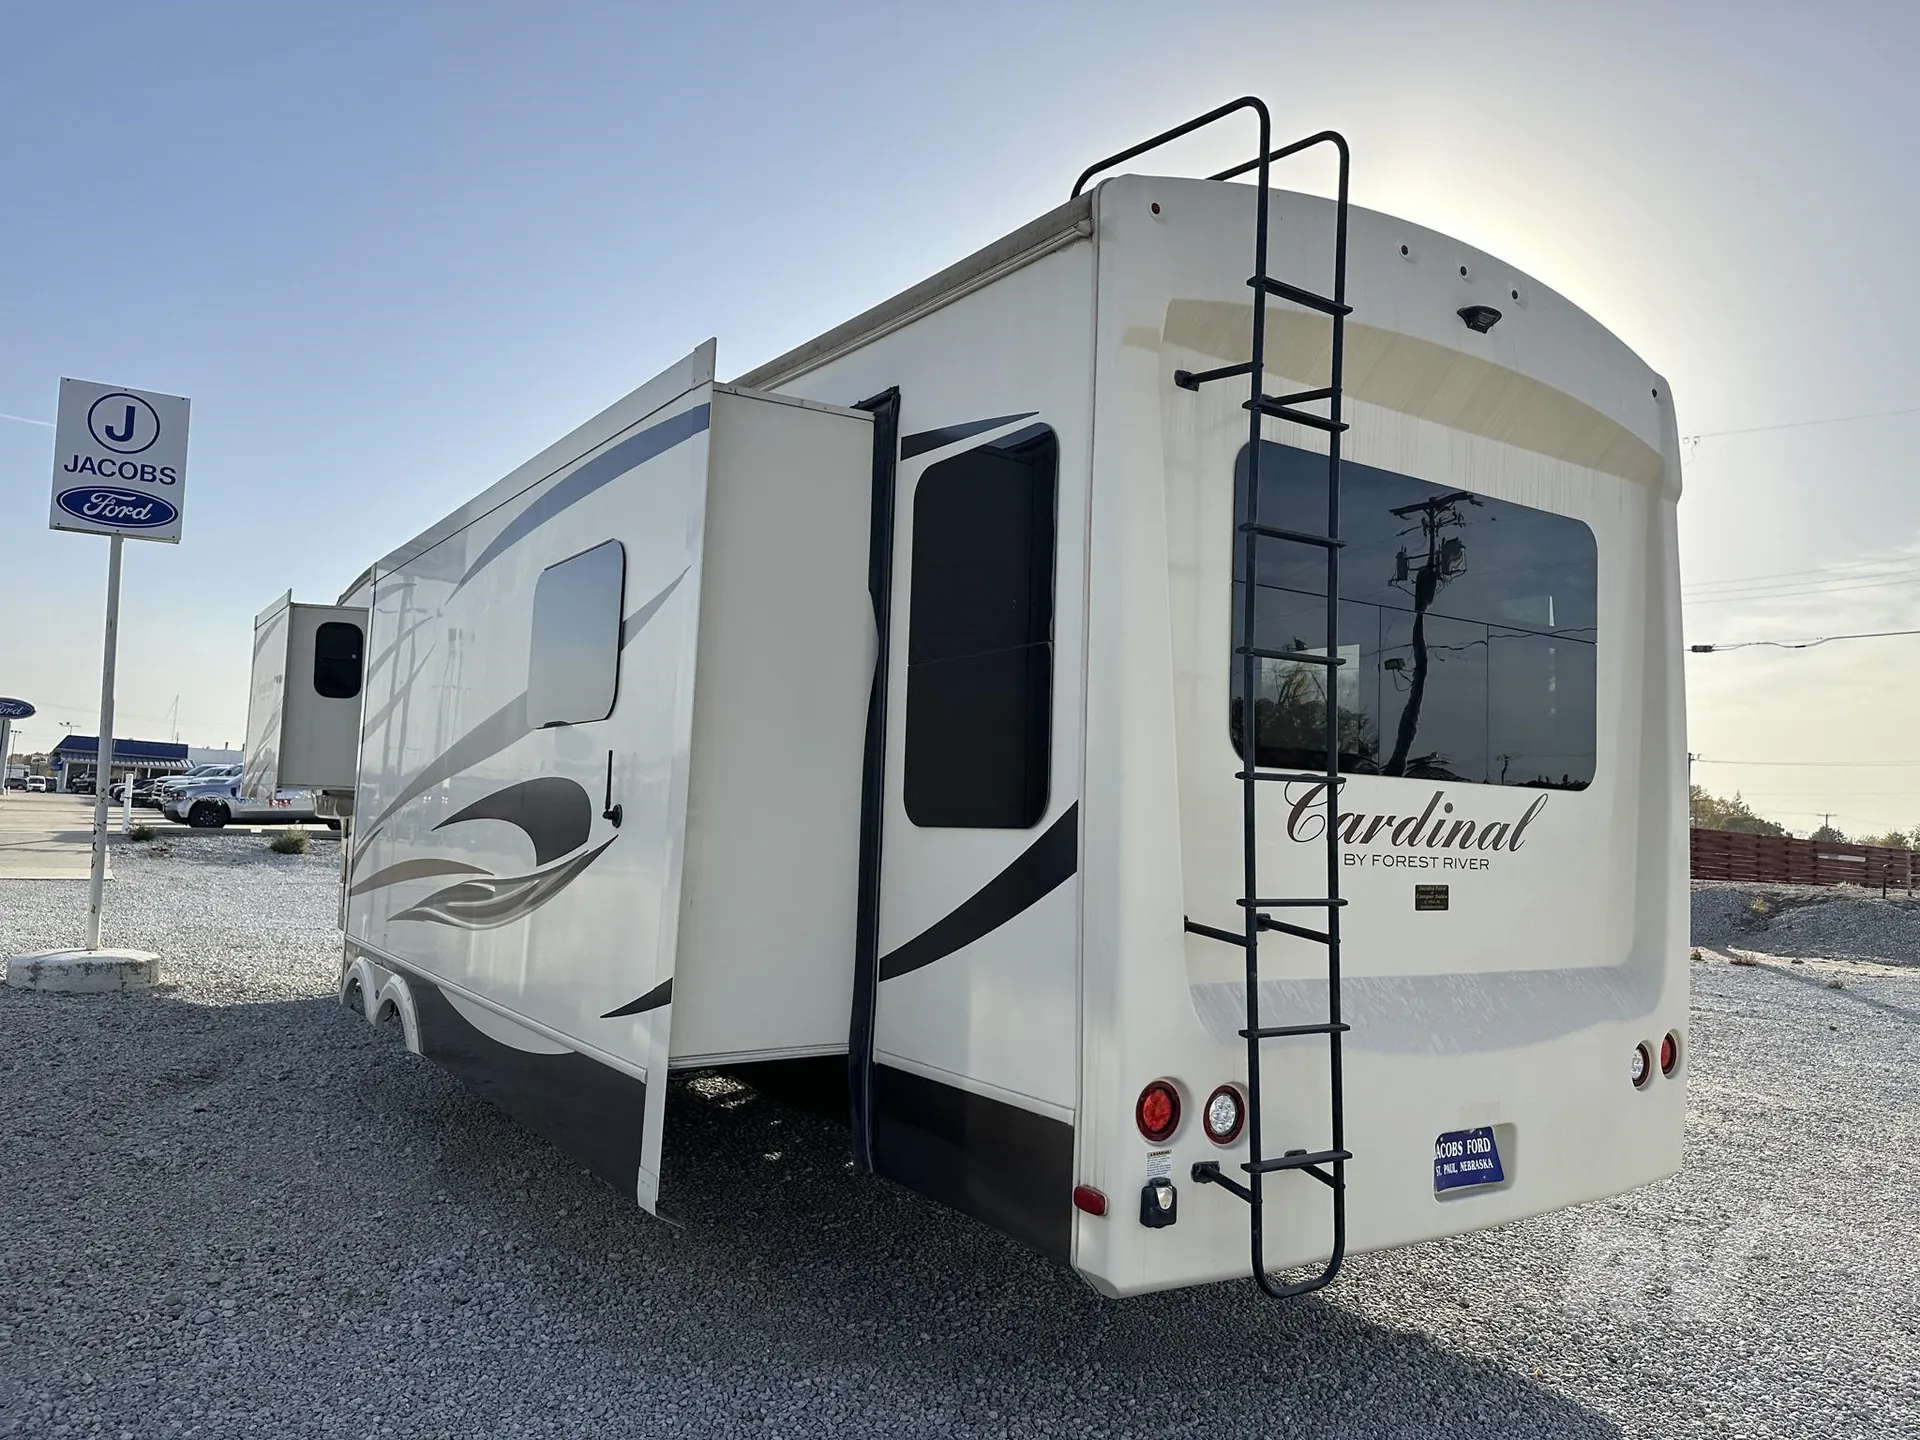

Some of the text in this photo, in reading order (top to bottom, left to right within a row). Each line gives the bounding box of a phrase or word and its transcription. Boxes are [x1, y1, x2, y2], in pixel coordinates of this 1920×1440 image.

[105, 405, 136, 442] J
[63, 454, 177, 486] JACOBS
[83, 492, 153, 520] Ford
[1284, 773, 1549, 852] Cardinal
[1343, 853, 1490, 871] BY FOREST RIVER
[1434, 1137, 1491, 1160] ACOBS FORD
[1460, 1158, 1494, 1172] NEBRASKA
